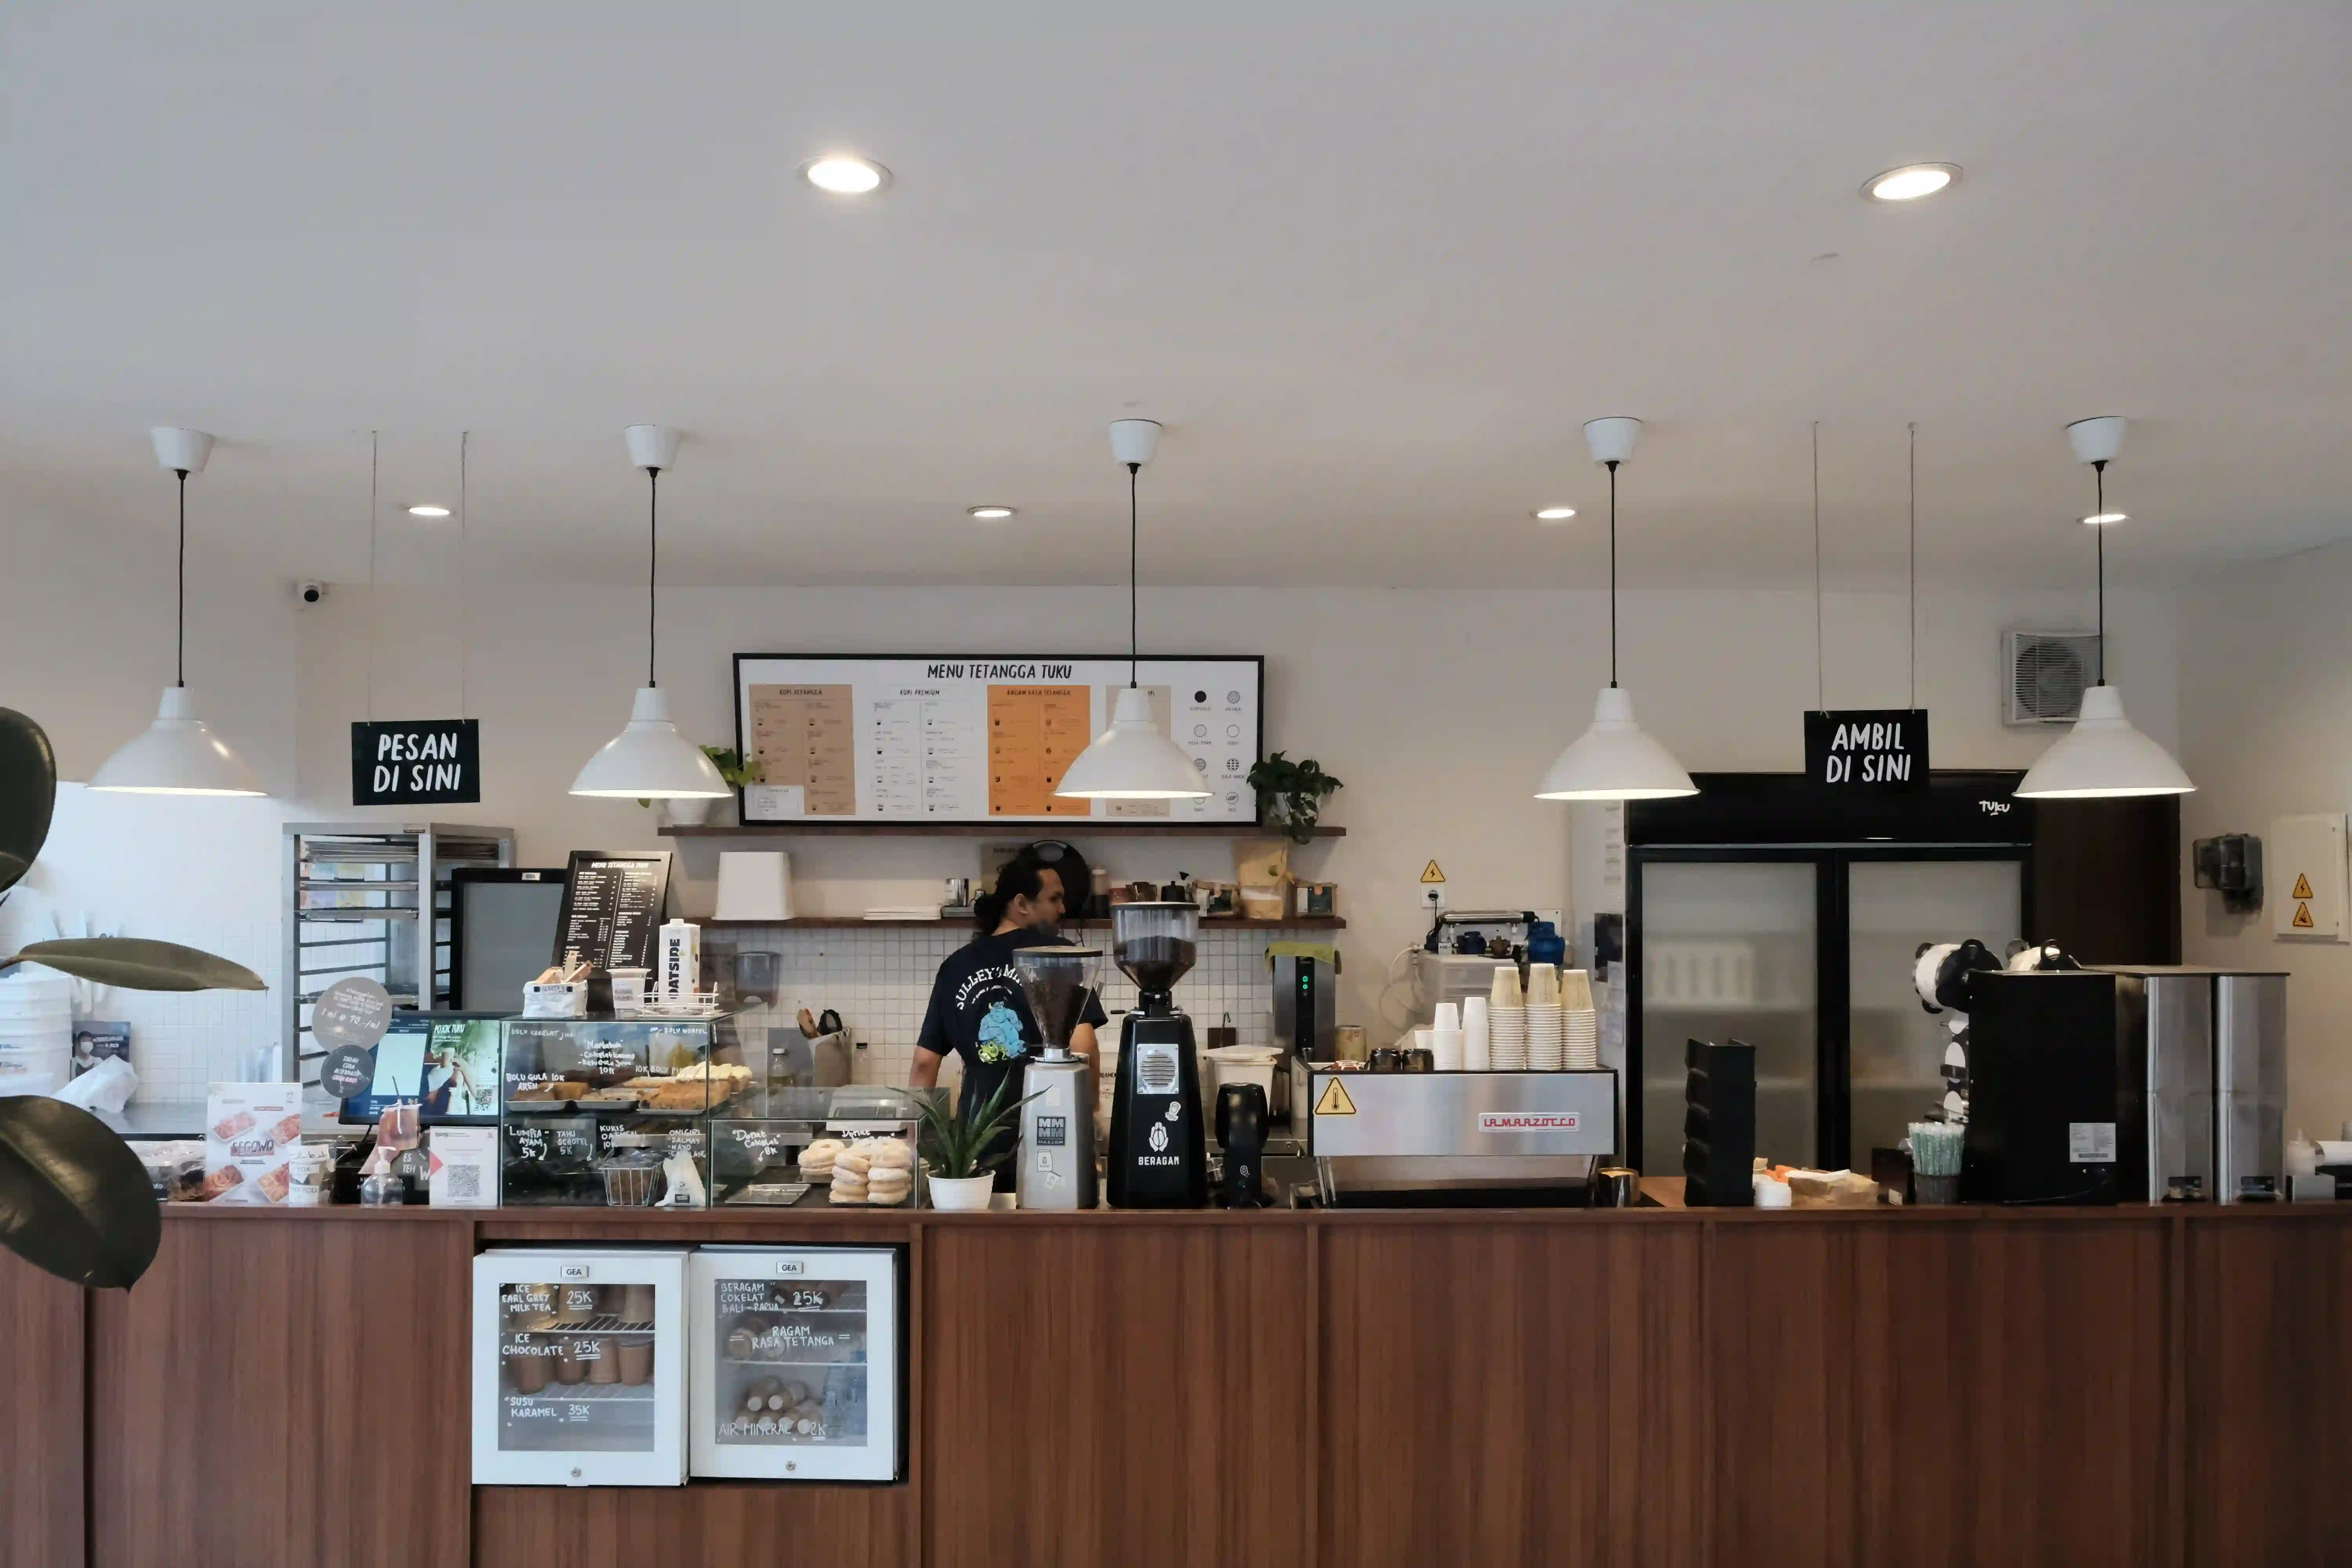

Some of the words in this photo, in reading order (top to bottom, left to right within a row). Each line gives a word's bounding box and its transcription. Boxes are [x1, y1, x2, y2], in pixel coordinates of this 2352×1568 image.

[927, 664, 964, 679] MENU
[969, 664, 1036, 679] TETANGGA
[1041, 664, 1072, 679] TUKU
[1831, 722, 1904, 751] AMBIL
[377, 733, 457, 761] PESAN
[1826, 755, 1851, 783] DI
[1862, 754, 1911, 782] SINI
[374, 764, 400, 792] DI
[410, 764, 461, 791] SINI
[668, 938, 680, 999] OATSIDE
[955, 966, 1002, 1010] SULLEY'S
[434, 1024, 451, 1034] POJOK
[452, 1024, 465, 1033] TUKU
[599, 1066, 615, 1075] 10K
[635, 1064, 648, 1073] 10K
[650, 1064, 668, 1074] BOLU
[506, 1073, 526, 1082] BOLU
[528, 1072, 548, 1082] GULA
[552, 1073, 565, 1082] 10K
[517, 1082, 538, 1091] AREN
[519, 1137, 543, 1147] AYAM
[557, 1138, 588, 1146] SCHOTEL
[560, 1146, 573, 1155] 5K
[403, 1153, 412, 1163] ES
[1138, 1156, 1180, 1165] BERAGAM
[403, 1164, 416, 1174] TEH
[566, 1267, 582, 1276] GEA
[515, 1285, 530, 1293] ICE
[721, 1283, 764, 1292] BERAGAM
[502, 1294, 524, 1303] EARL
[526, 1294, 550, 1303] GREY
[566, 1290, 592, 1305] 25K
[720, 1294, 764, 1302] COKELAT
[793, 1291, 823, 1305] 25K
[510, 1304, 530, 1312] MILK
[532, 1303, 551, 1312] TEA
[722, 1304, 744, 1313] BALI
[754, 1303, 779, 1312] PAPUA
[772, 1326, 810, 1337] RAGAM
[515, 1334, 530, 1344] ICE
[752, 1336, 780, 1350] RASA
[783, 1336, 834, 1347] TETANGA
[502, 1345, 564, 1356] CHOCOLATE
[573, 1341, 601, 1354] 25K
[510, 1397, 534, 1406] SUSU
[511, 1407, 557, 1418] KARAMEL
[568, 1404, 590, 1416] 35K
[719, 1423, 739, 1436] AIR
[744, 1422, 792, 1436] MINERAL
